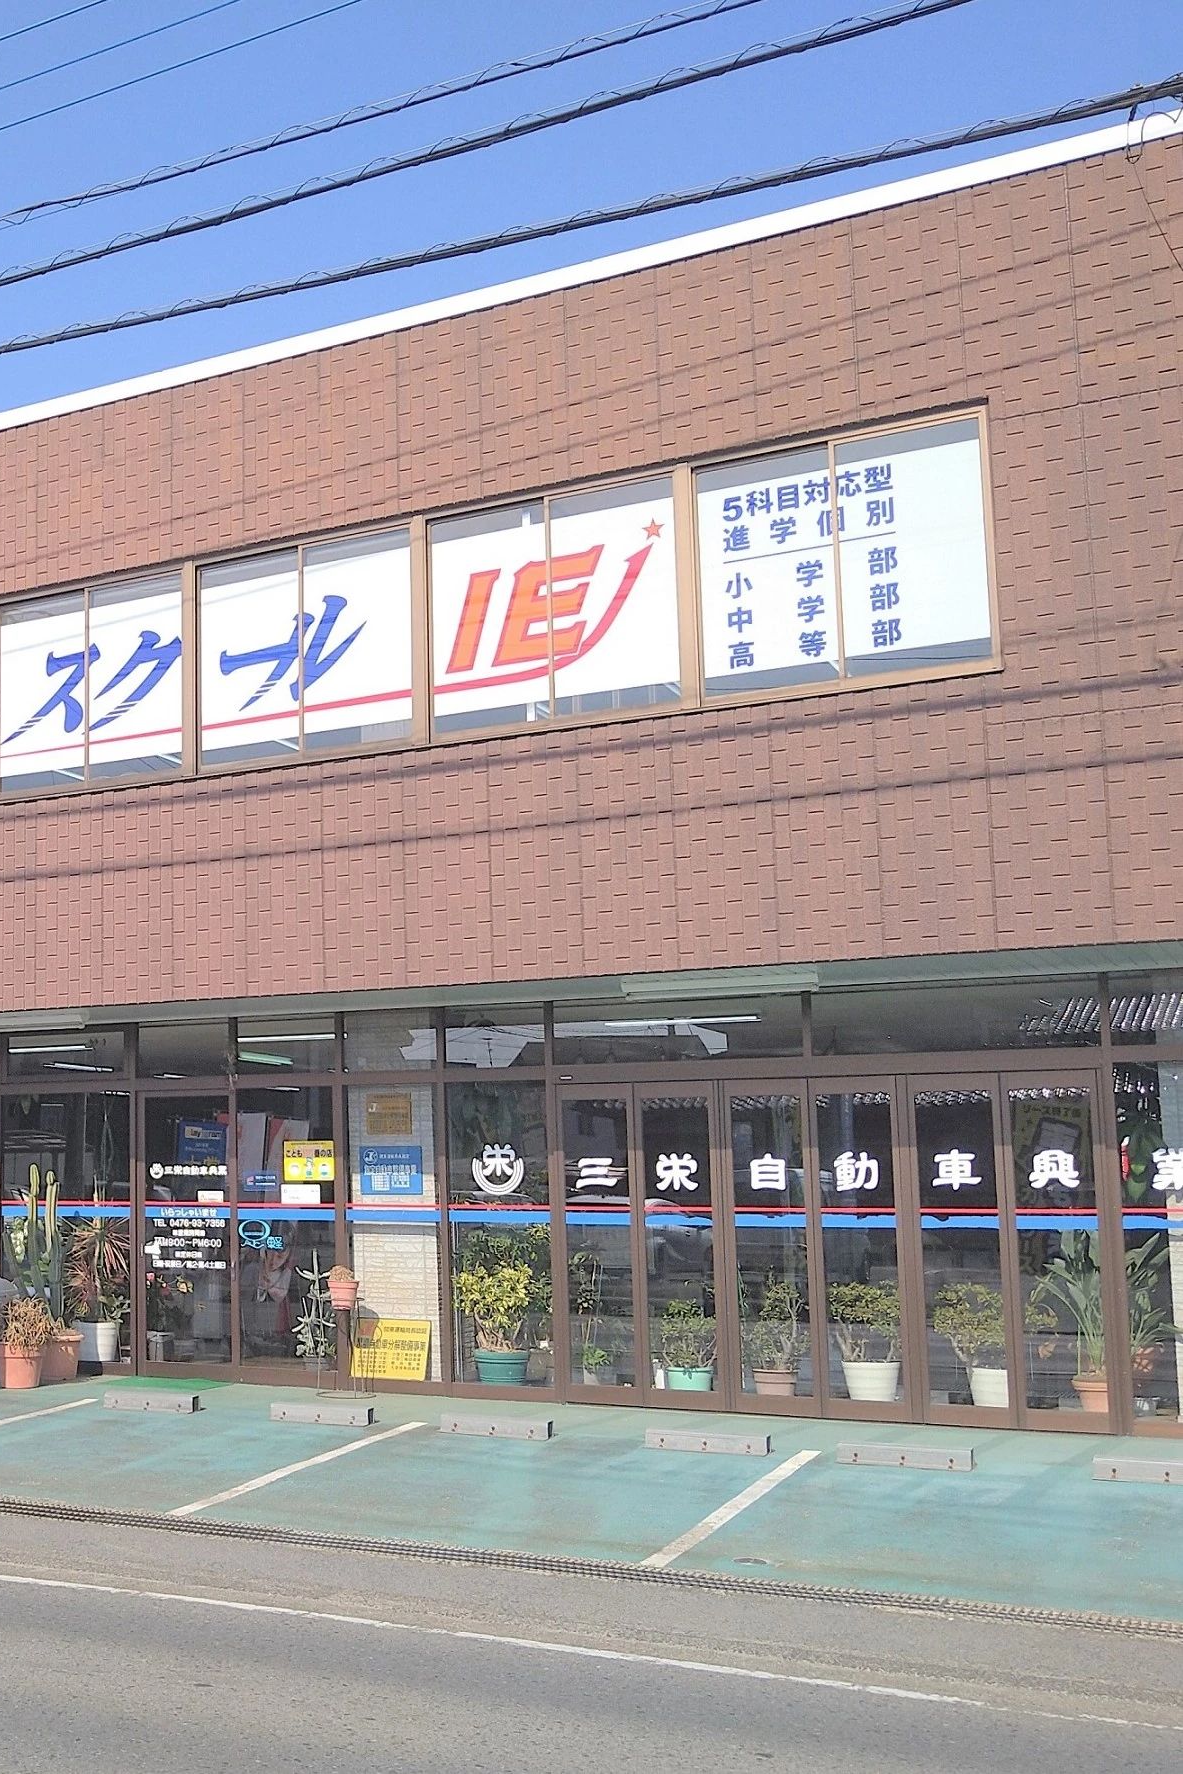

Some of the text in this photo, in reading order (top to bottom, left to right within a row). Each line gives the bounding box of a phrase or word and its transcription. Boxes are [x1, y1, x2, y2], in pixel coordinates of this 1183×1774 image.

[722, 463, 894, 522] 5科目対応型
[722, 497, 895, 553] 進学個別
[725, 546, 898, 600] 小学部
[727, 582, 900, 634] 中学部
[728, 618, 903, 670] 高等部
[153, 1219, 168, 1228] TEL
[160, 1207, 218, 1217] いらっしゃいませ
